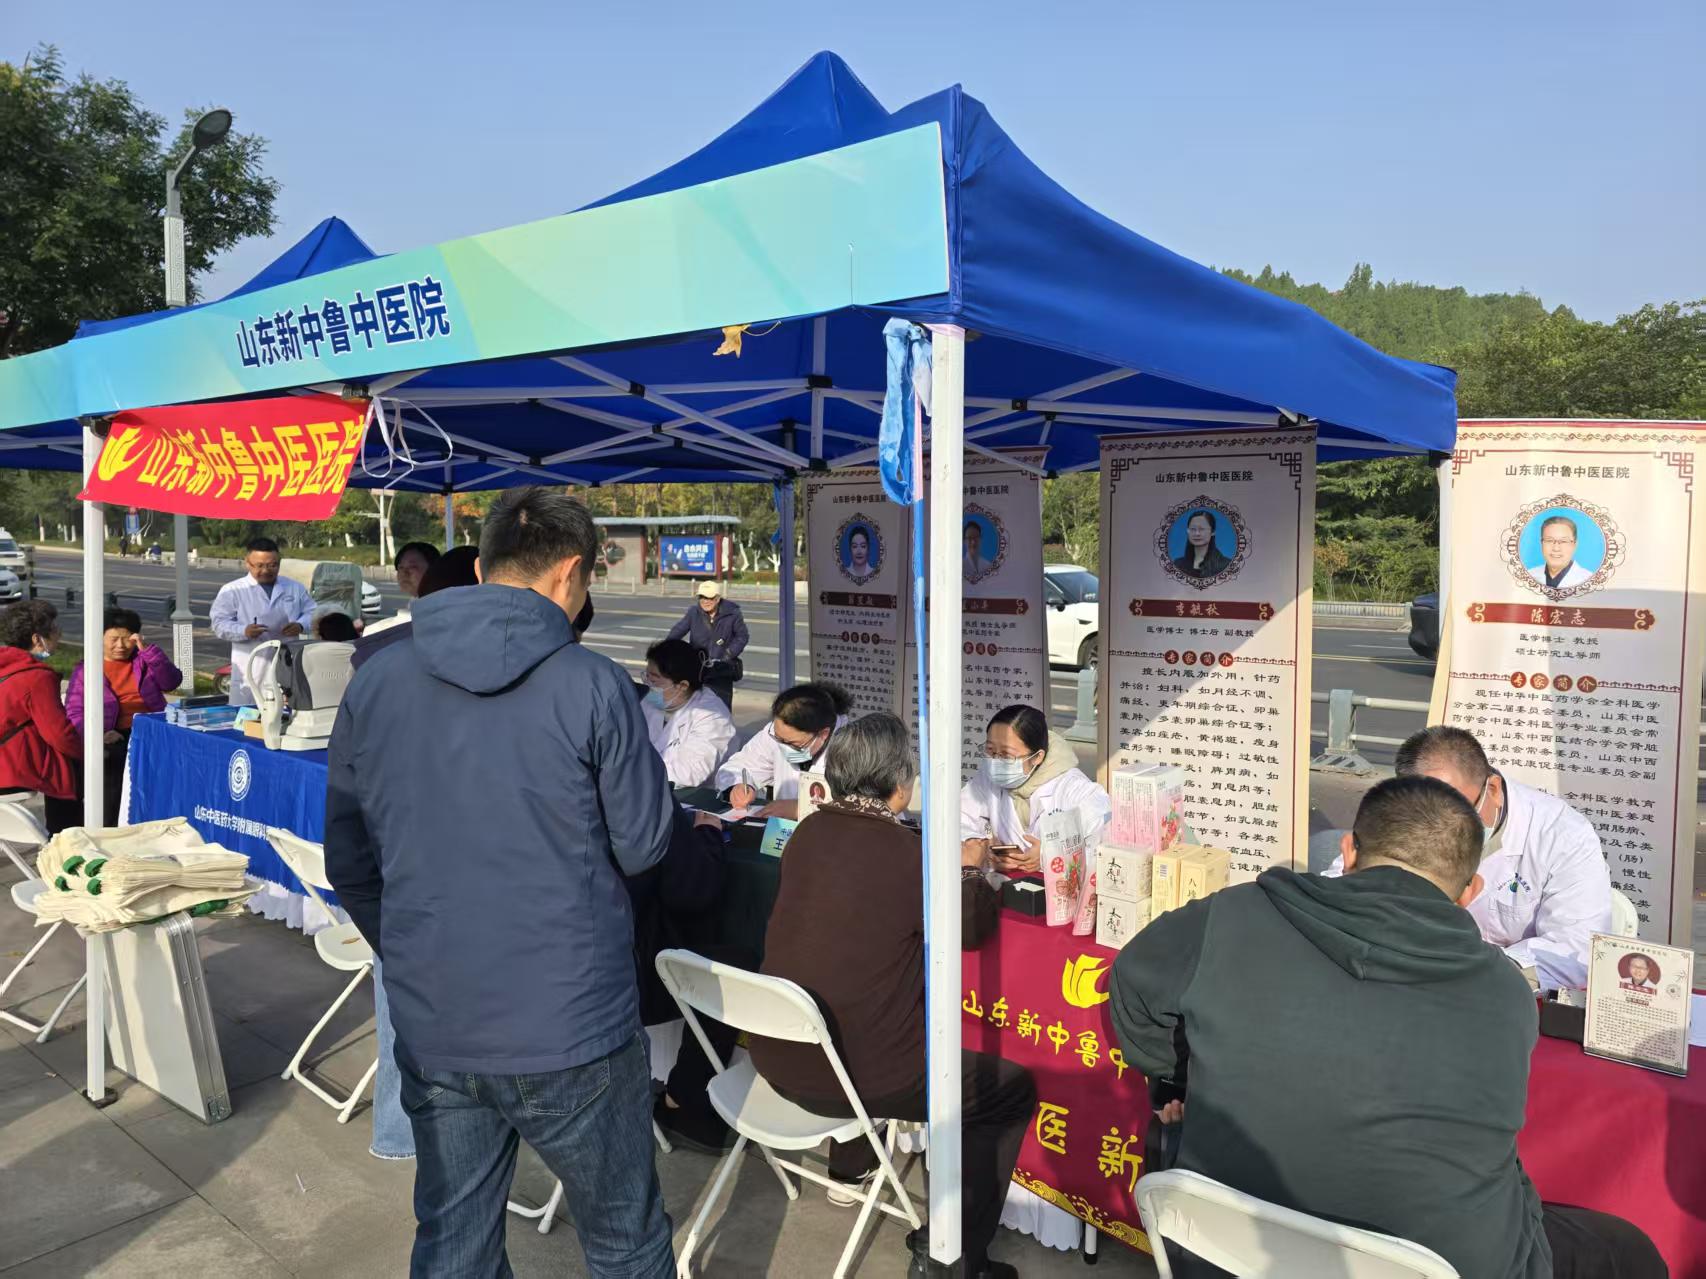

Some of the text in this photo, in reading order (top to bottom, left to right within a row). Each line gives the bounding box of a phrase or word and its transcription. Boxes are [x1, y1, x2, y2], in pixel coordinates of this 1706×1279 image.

[236, 276, 450, 368] 山东新中鲁中医院
[137, 414, 365, 500] 山东新中鲁中医医院
[1155, 471, 1254, 483] 山东新中鲁中医医院
[1505, 464, 1630, 479] 山东新中鲁中医医院
[1530, 608, 1586, 625] 陈宏志
[1146, 626, 1254, 638] 医学博士 博士后 副教授
[1519, 633, 1599, 646] 医学博士 教授
[1167, 651, 1232, 666] 专家简介
[1515, 648, 1601, 660] 硕士研究生导师
[965, 677, 1034, 689] 山东中医药大学
[1513, 673, 1596, 692] 专家简介
[961, 688, 1034, 701] 生导师，从事中
[1475, 689, 1660, 710] 现任中华中医药学会全科医学
[1452, 714, 1659, 738] 药学会中医全科医学专业委员会常
[1481, 744, 1657, 766] 委员会常务委员，山东中西
[1488, 757, 1656, 780] 学会健康促进专业委员会副
[194, 804, 270, 841] 山东中医药大学附属眼科
[1571, 805, 1655, 823] 老中医姜建
[962, 990, 1128, 1080] 山东新中鲁中
